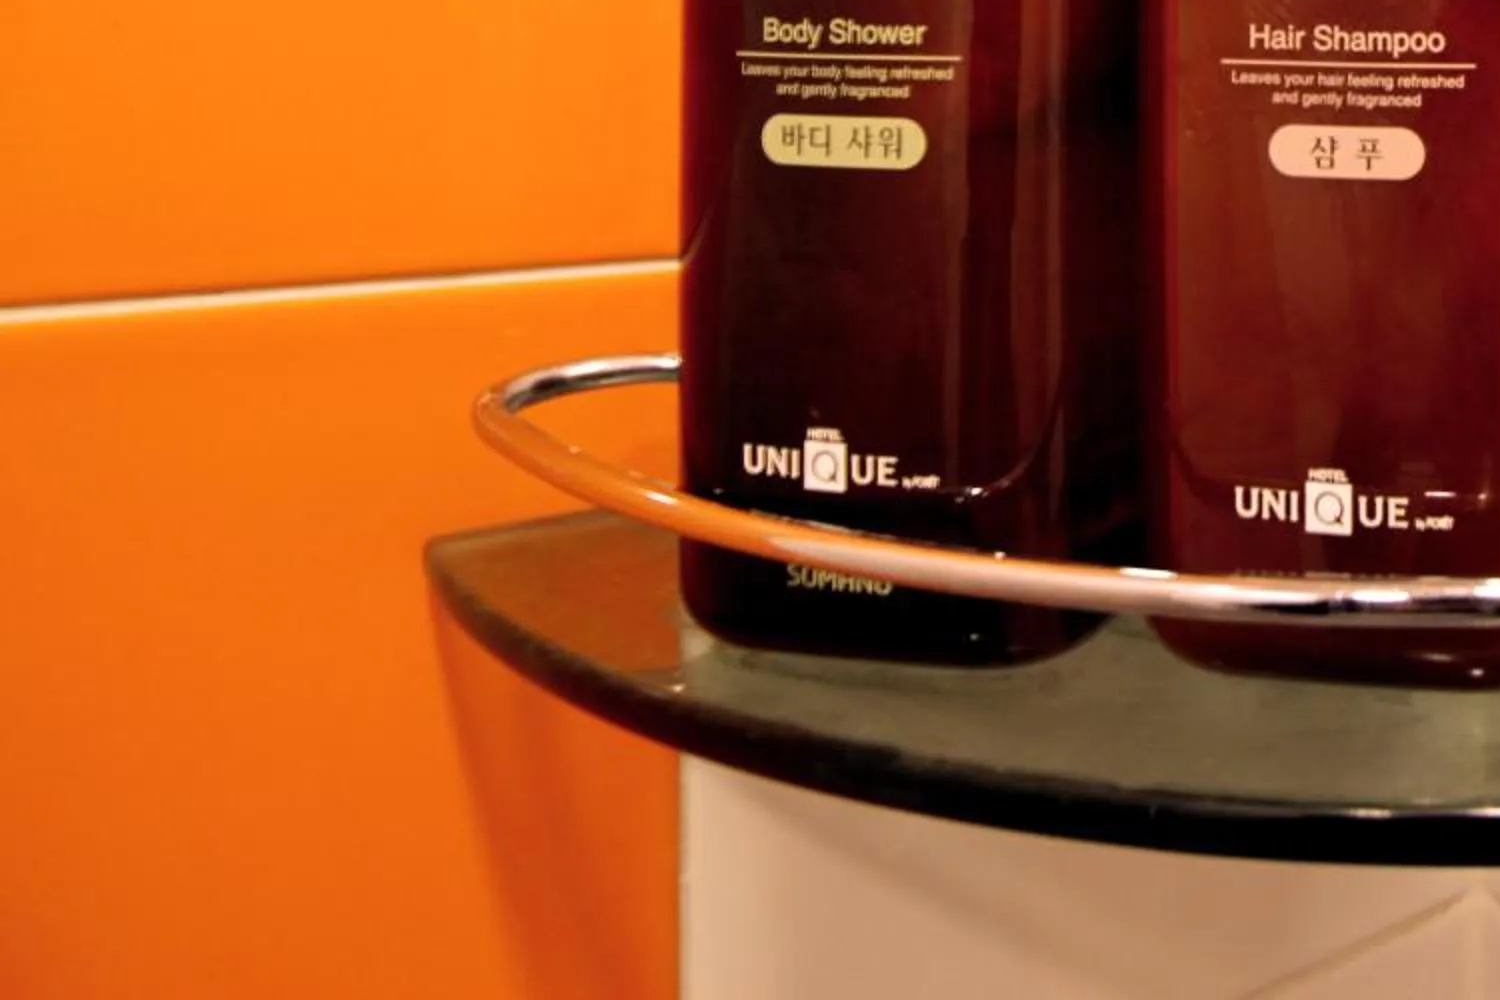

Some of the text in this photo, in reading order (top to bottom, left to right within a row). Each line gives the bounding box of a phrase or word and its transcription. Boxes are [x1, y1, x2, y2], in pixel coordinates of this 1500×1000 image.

[763, 17, 928, 49] Body Shower
[1249, 24, 1446, 59] Hair Shampoo
[741, 61, 954, 82] Leaves your body feeling refreshed
[1231, 70, 1465, 91] Leaves your hair feeling refreshed
[776, 83, 910, 101] and gently fragranced
[1272, 91, 1422, 110] and gently fragranced
[782, 124, 901, 159] 바디 샤워
